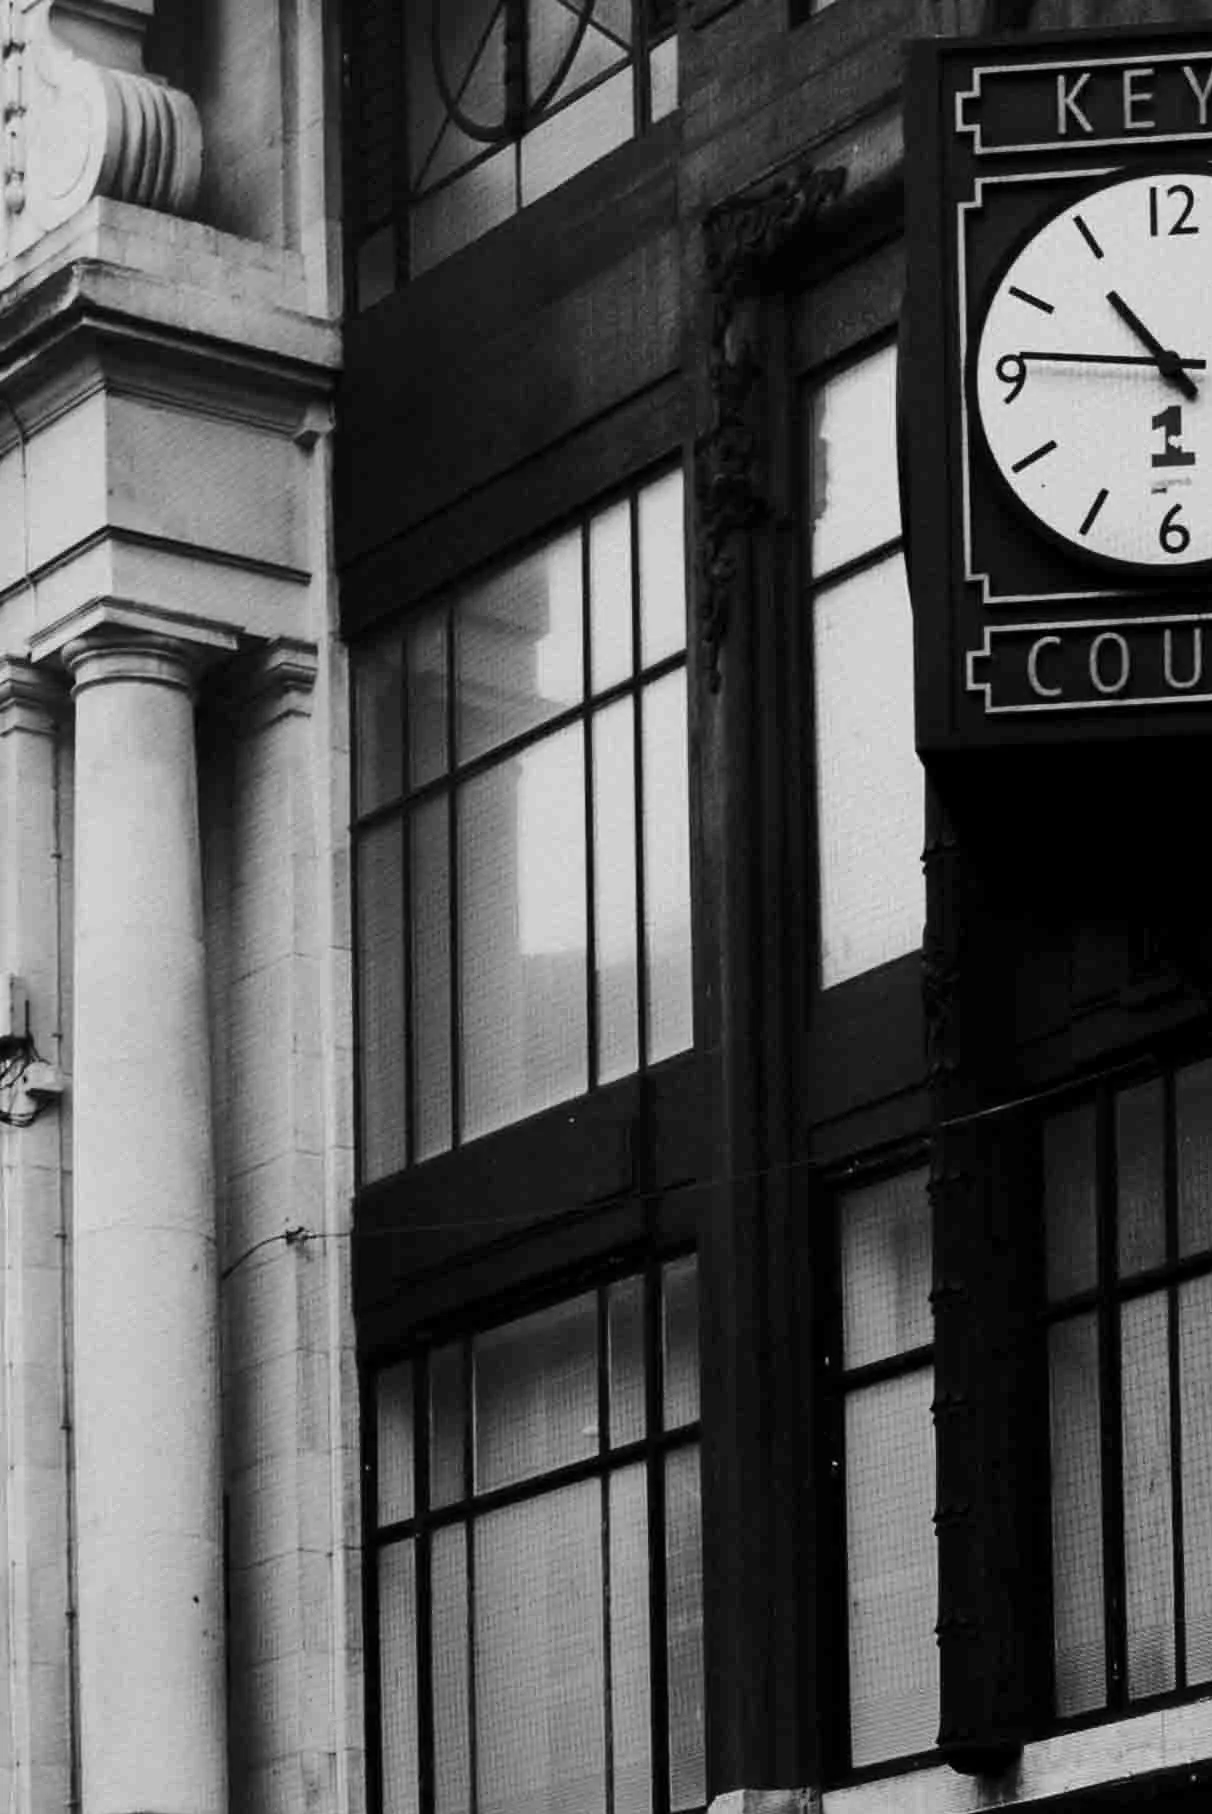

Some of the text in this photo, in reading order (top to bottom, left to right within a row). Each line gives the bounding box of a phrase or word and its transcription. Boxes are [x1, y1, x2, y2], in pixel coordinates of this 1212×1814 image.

[1148, 184, 1199, 236] 12
[996, 353, 1028, 404] 9
[1158, 503, 1191, 555] 6
